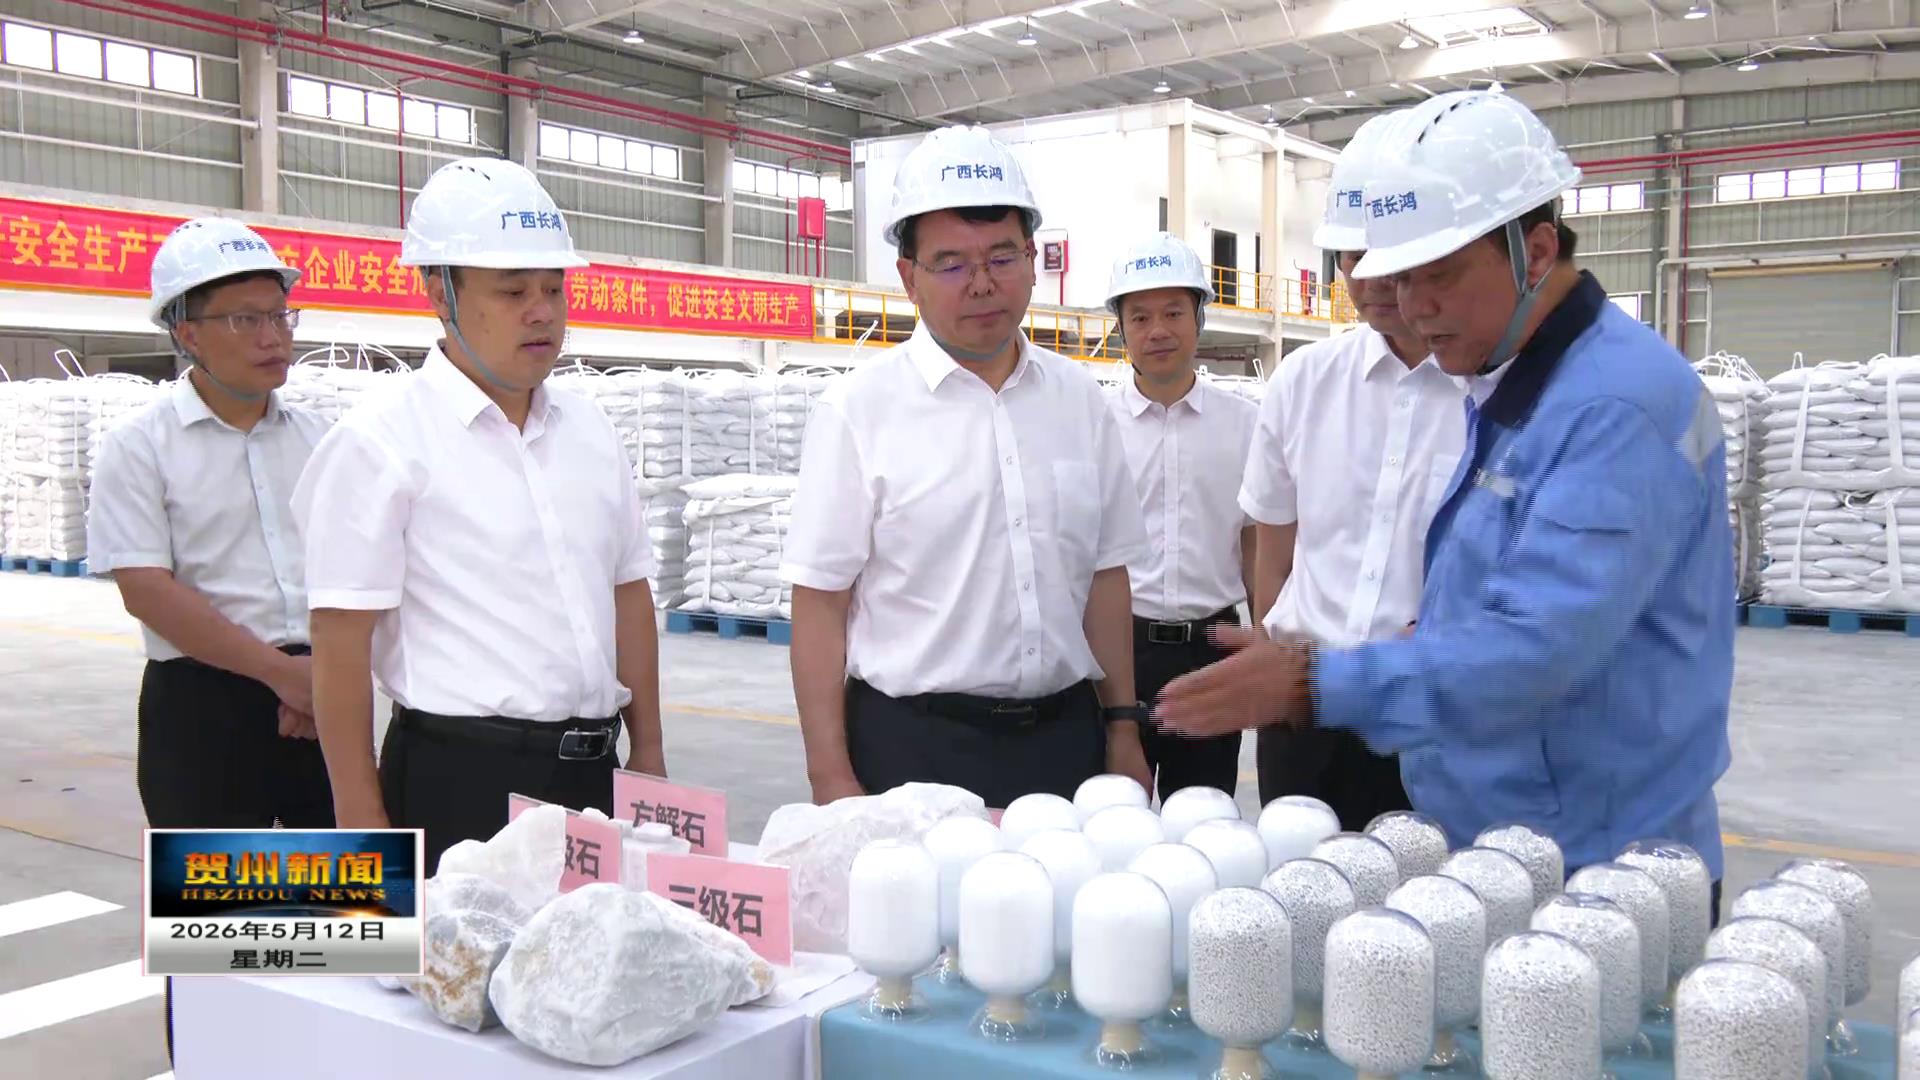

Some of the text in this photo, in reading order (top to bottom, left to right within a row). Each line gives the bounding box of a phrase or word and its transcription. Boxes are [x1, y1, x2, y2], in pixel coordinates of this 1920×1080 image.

[941, 164, 1003, 182] 广西长鸿
[501, 211, 561, 231] 广西长鸿
[0, 215, 165, 274] 安全生产
[1125, 255, 1171, 274] 广西长鸿
[630, 800, 705, 848] 方解石
